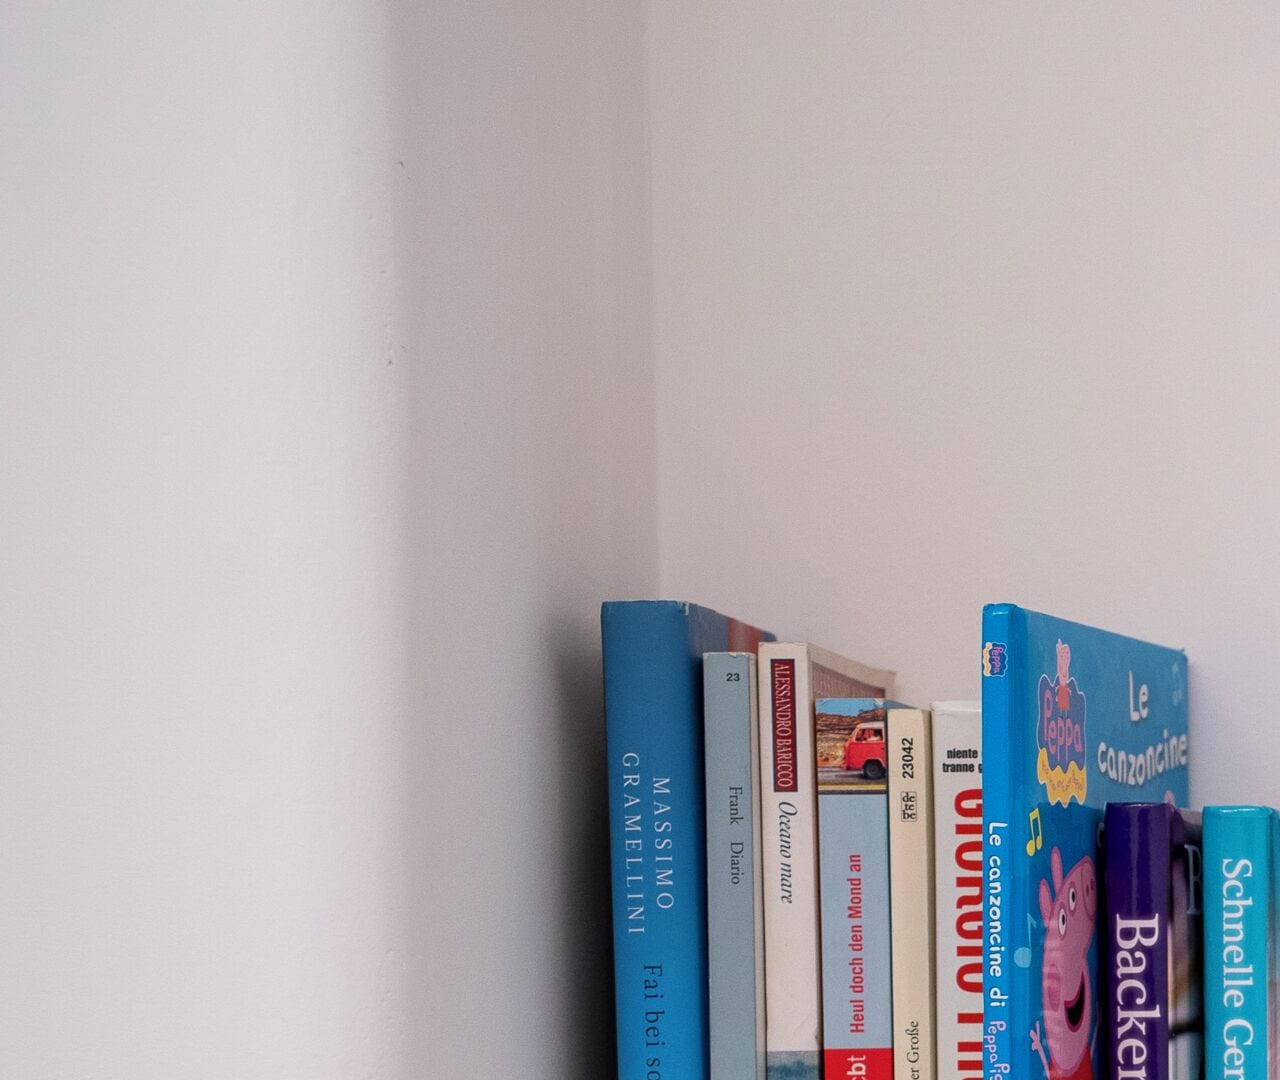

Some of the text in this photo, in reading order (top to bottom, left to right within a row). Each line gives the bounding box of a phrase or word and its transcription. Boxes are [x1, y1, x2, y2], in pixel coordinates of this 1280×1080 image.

[726, 672, 741, 682] 23
[1128, 670, 1149, 722] Le
[775, 663, 793, 788] ALESSANDRO BARICCO
[1044, 688, 1083, 765] Peppa
[902, 737, 915, 779] 23042
[942, 762, 975, 773] tranne
[946, 747, 979, 759] niente
[1098, 729, 1188, 786] canzoncine
[622, 753, 645, 934] GRAMELLINI
[653, 777, 674, 909] MASSIMO
[729, 786, 745, 885] Frank Diario
[778, 801, 798, 904] Oceano mare
[988, 822, 1009, 846] Le
[987, 855, 1006, 977] canzoncine
[1222, 858, 1254, 1008] Schnelle
[847, 854, 865, 1033] Heul doch den Mond an
[643, 964, 664, 999] Fai
[988, 986, 1009, 1007] di
[645, 1010, 666, 1047] bei
[905, 1020, 920, 1064] Große
[984, 1020, 1007, 1063] Peppa
